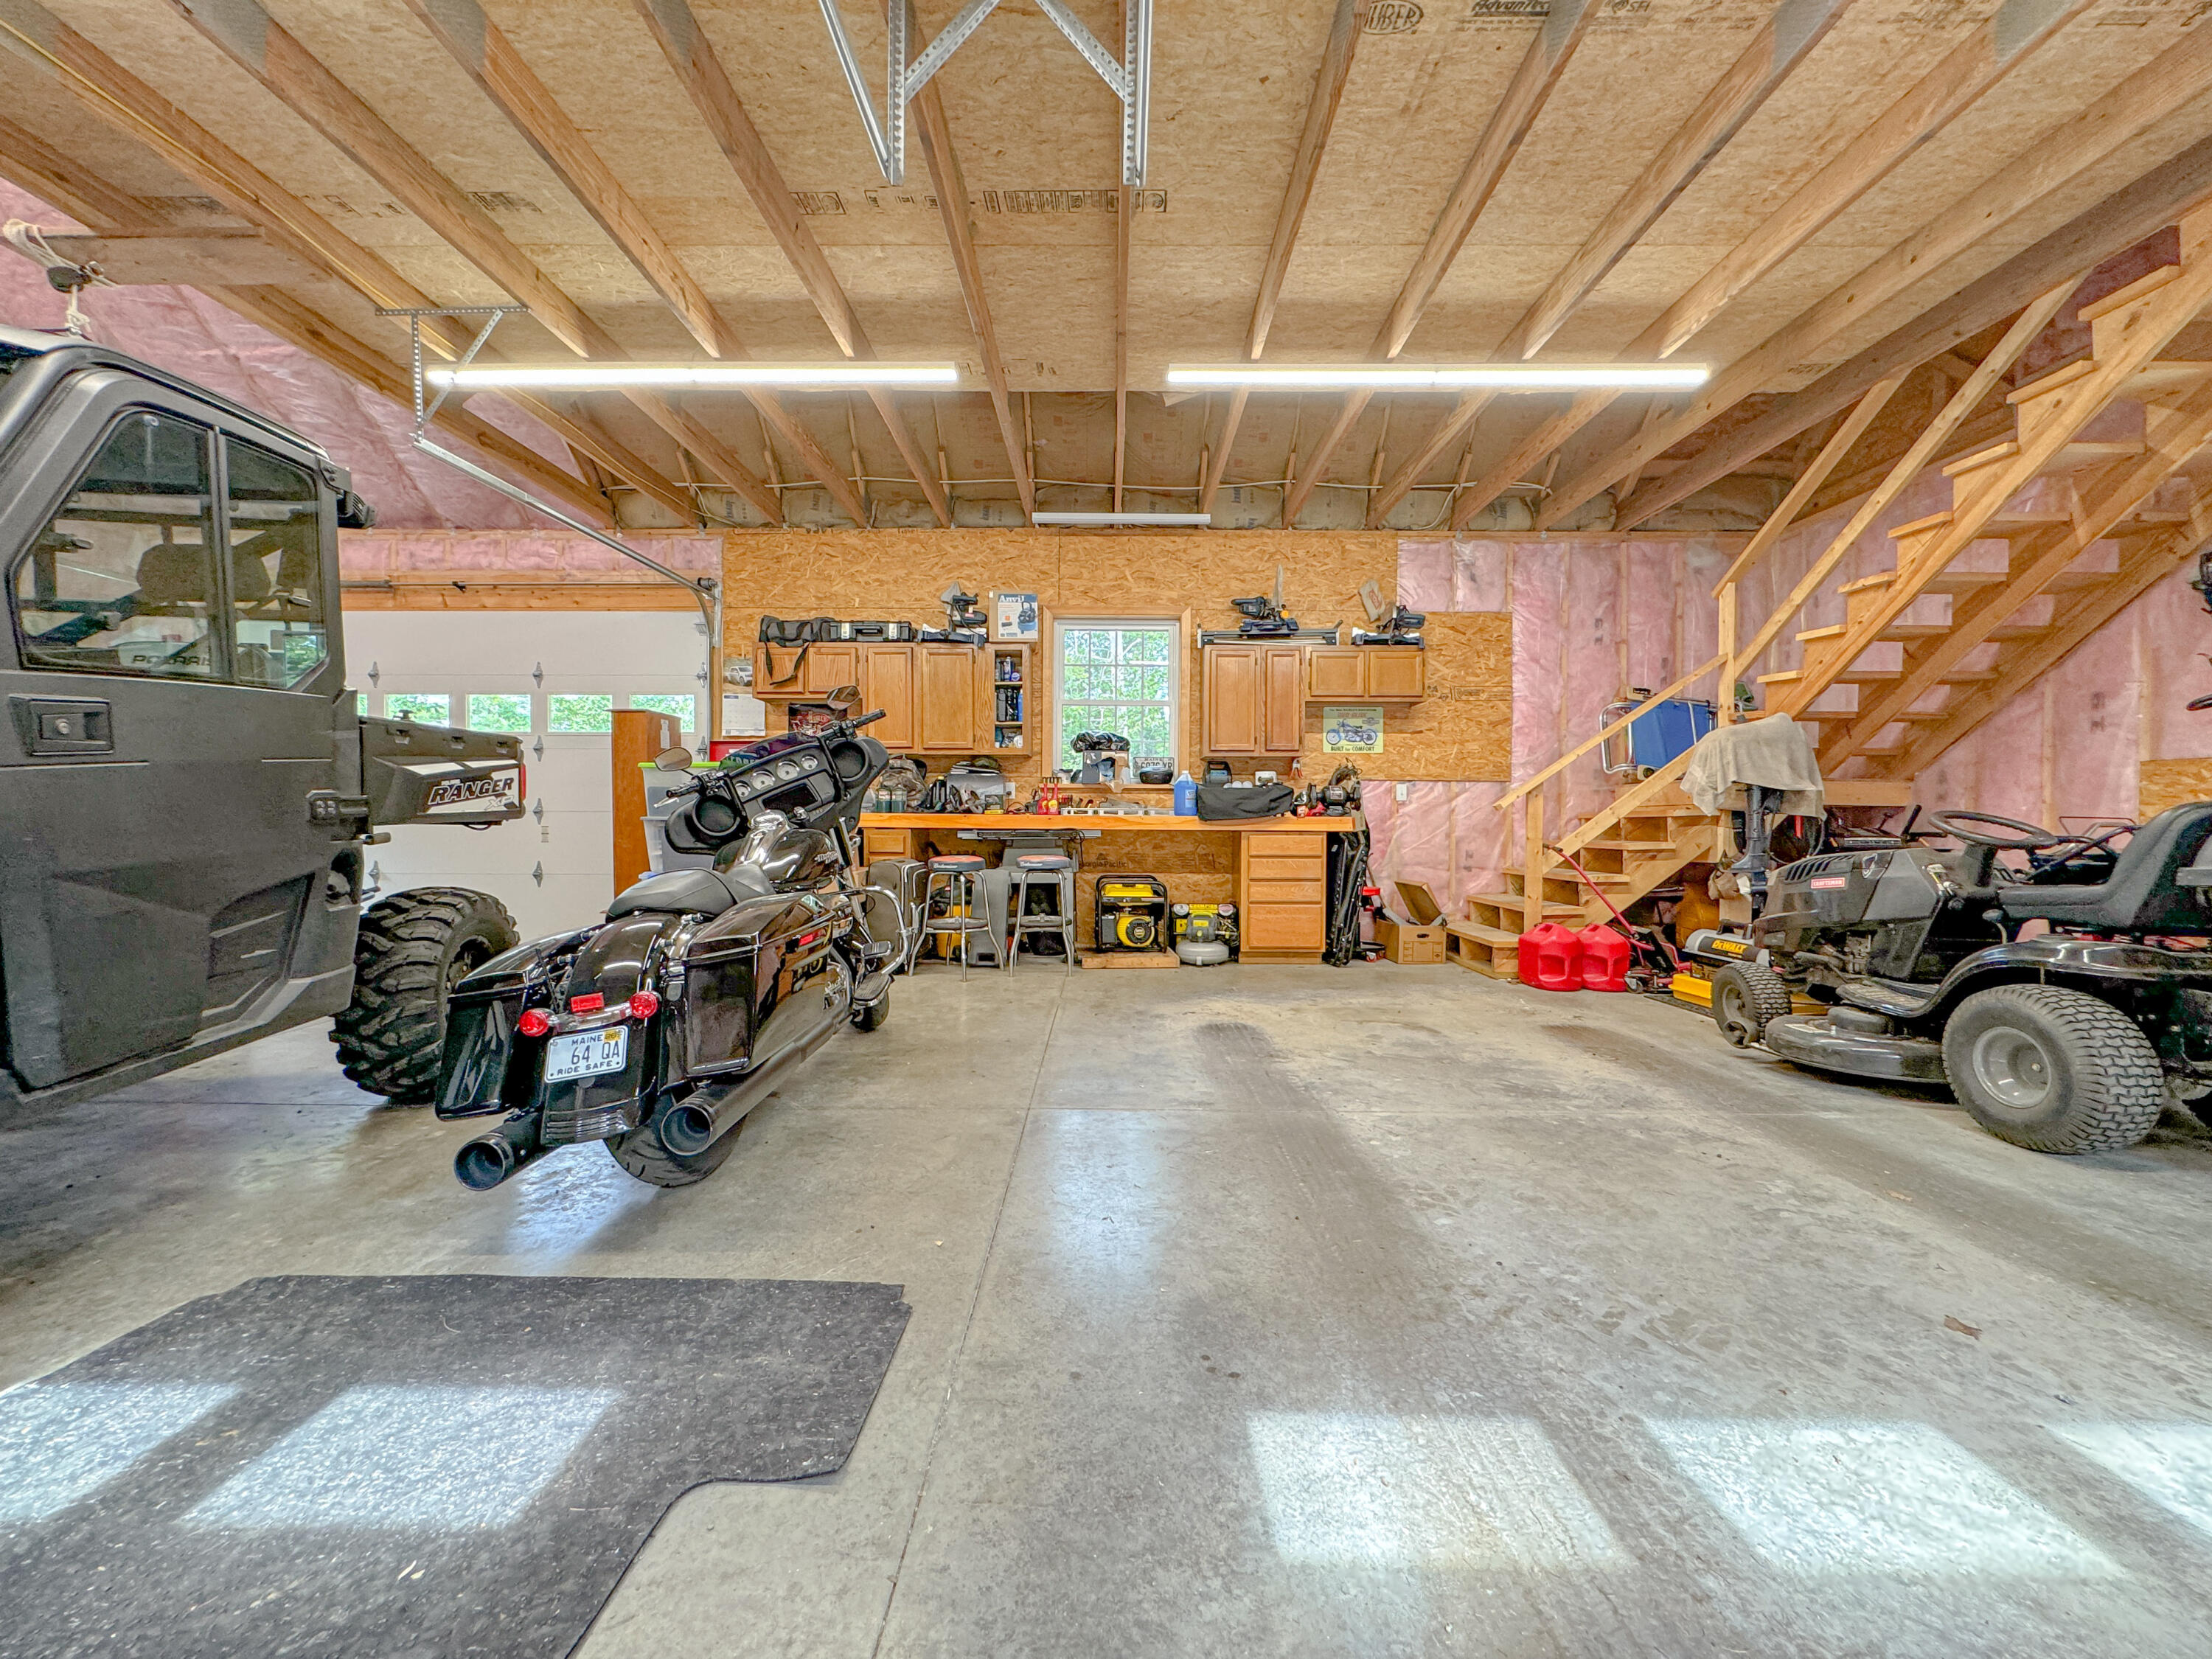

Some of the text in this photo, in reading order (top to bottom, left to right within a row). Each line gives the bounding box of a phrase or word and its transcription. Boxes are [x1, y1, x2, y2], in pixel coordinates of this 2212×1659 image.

[133, 655, 211, 665] POLARI
[428, 778, 515, 805] RANGER
[484, 795, 515, 810] XP
[571, 1034, 603, 1046] MAINE
[571, 1040, 620, 1065] 64 QA
[557, 1060, 613, 1076] RIDE SAFE
